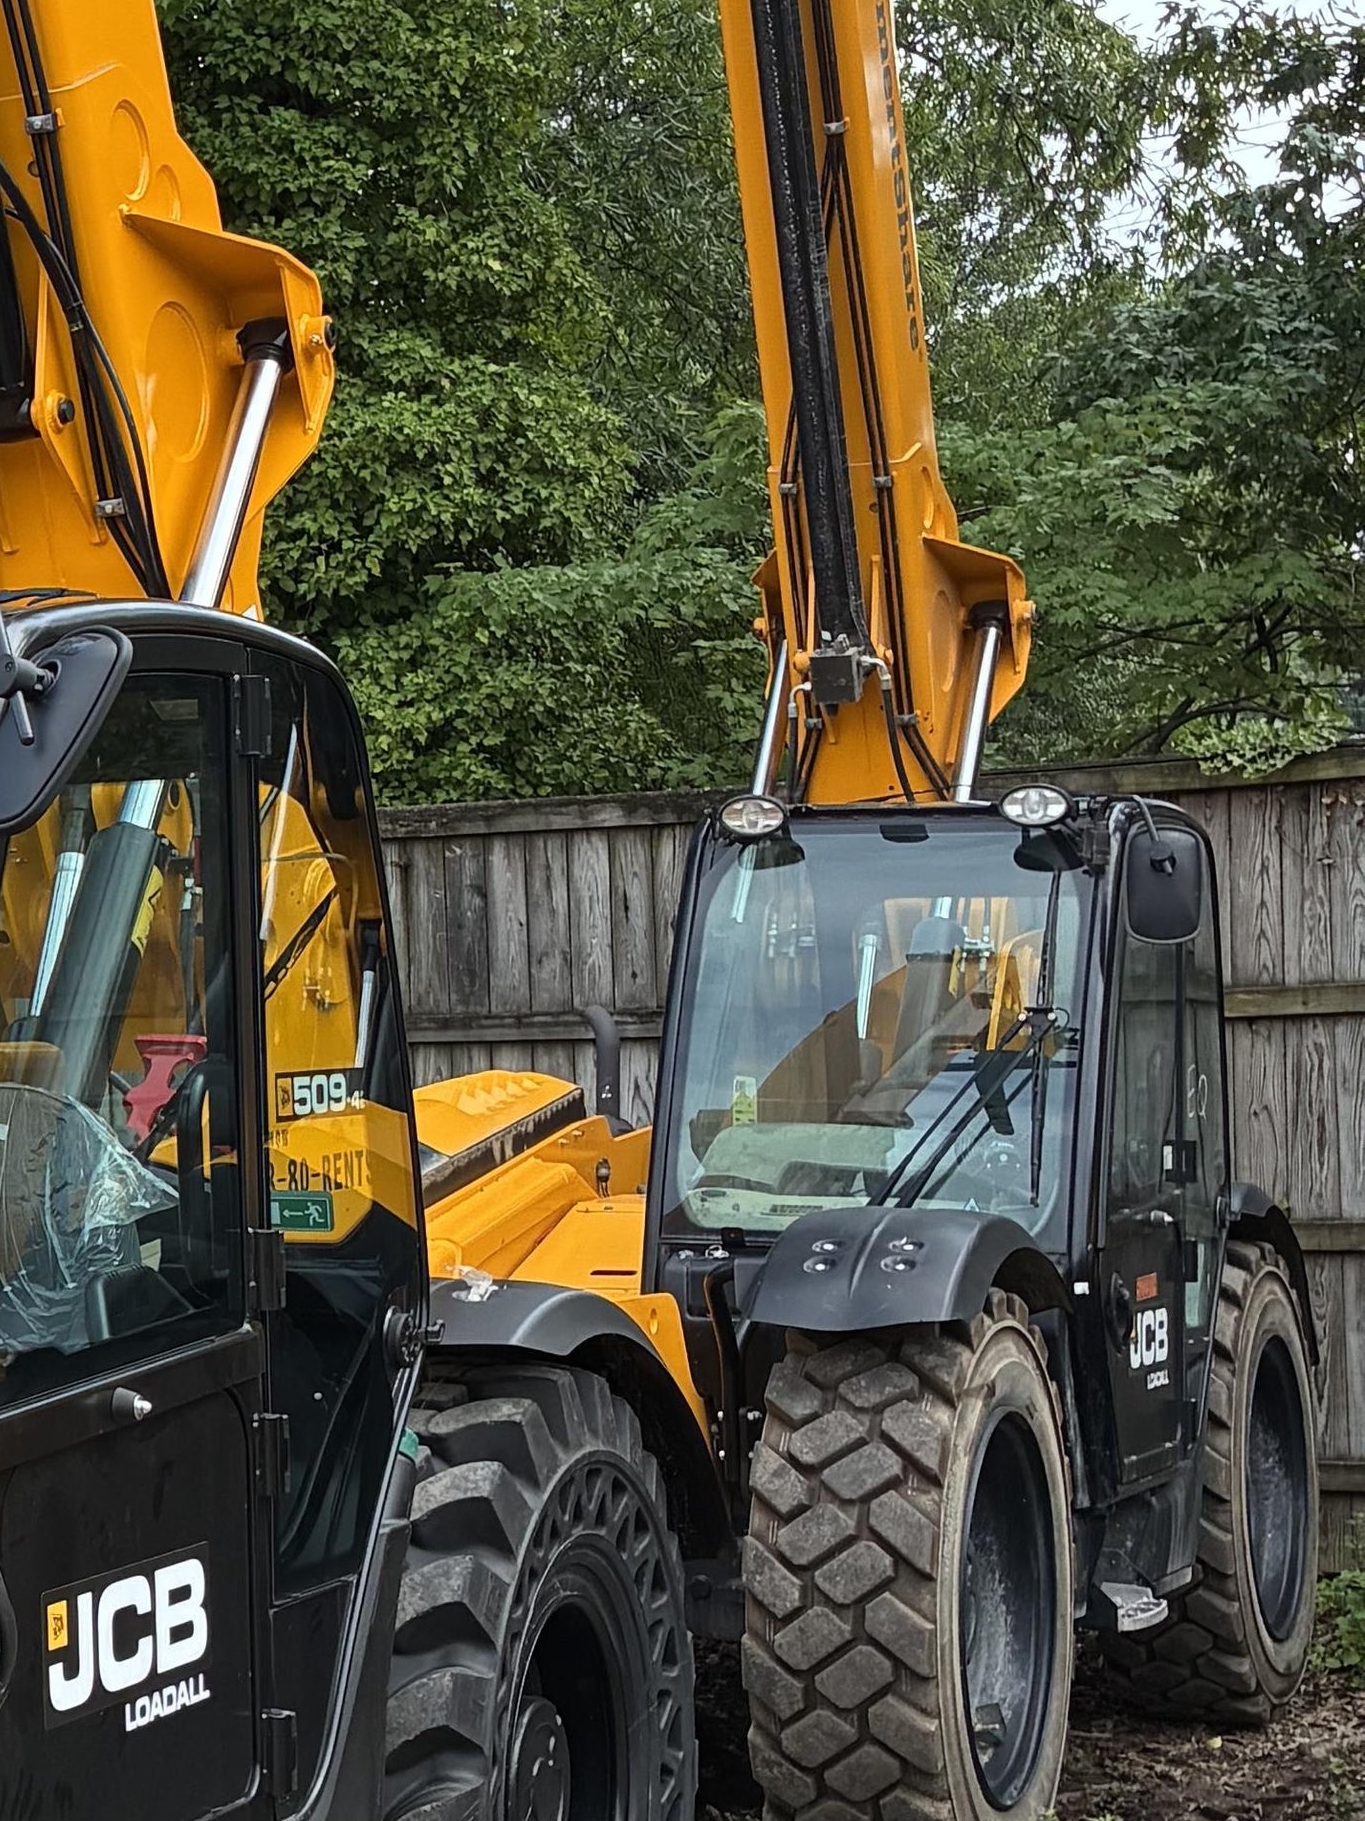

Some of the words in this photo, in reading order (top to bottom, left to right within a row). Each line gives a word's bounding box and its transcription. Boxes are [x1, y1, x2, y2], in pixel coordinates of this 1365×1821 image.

[1130, 1307, 1169, 1370] JCB
[48, 1558, 208, 1712] JCB
[125, 1673, 211, 1732] LOADALL
